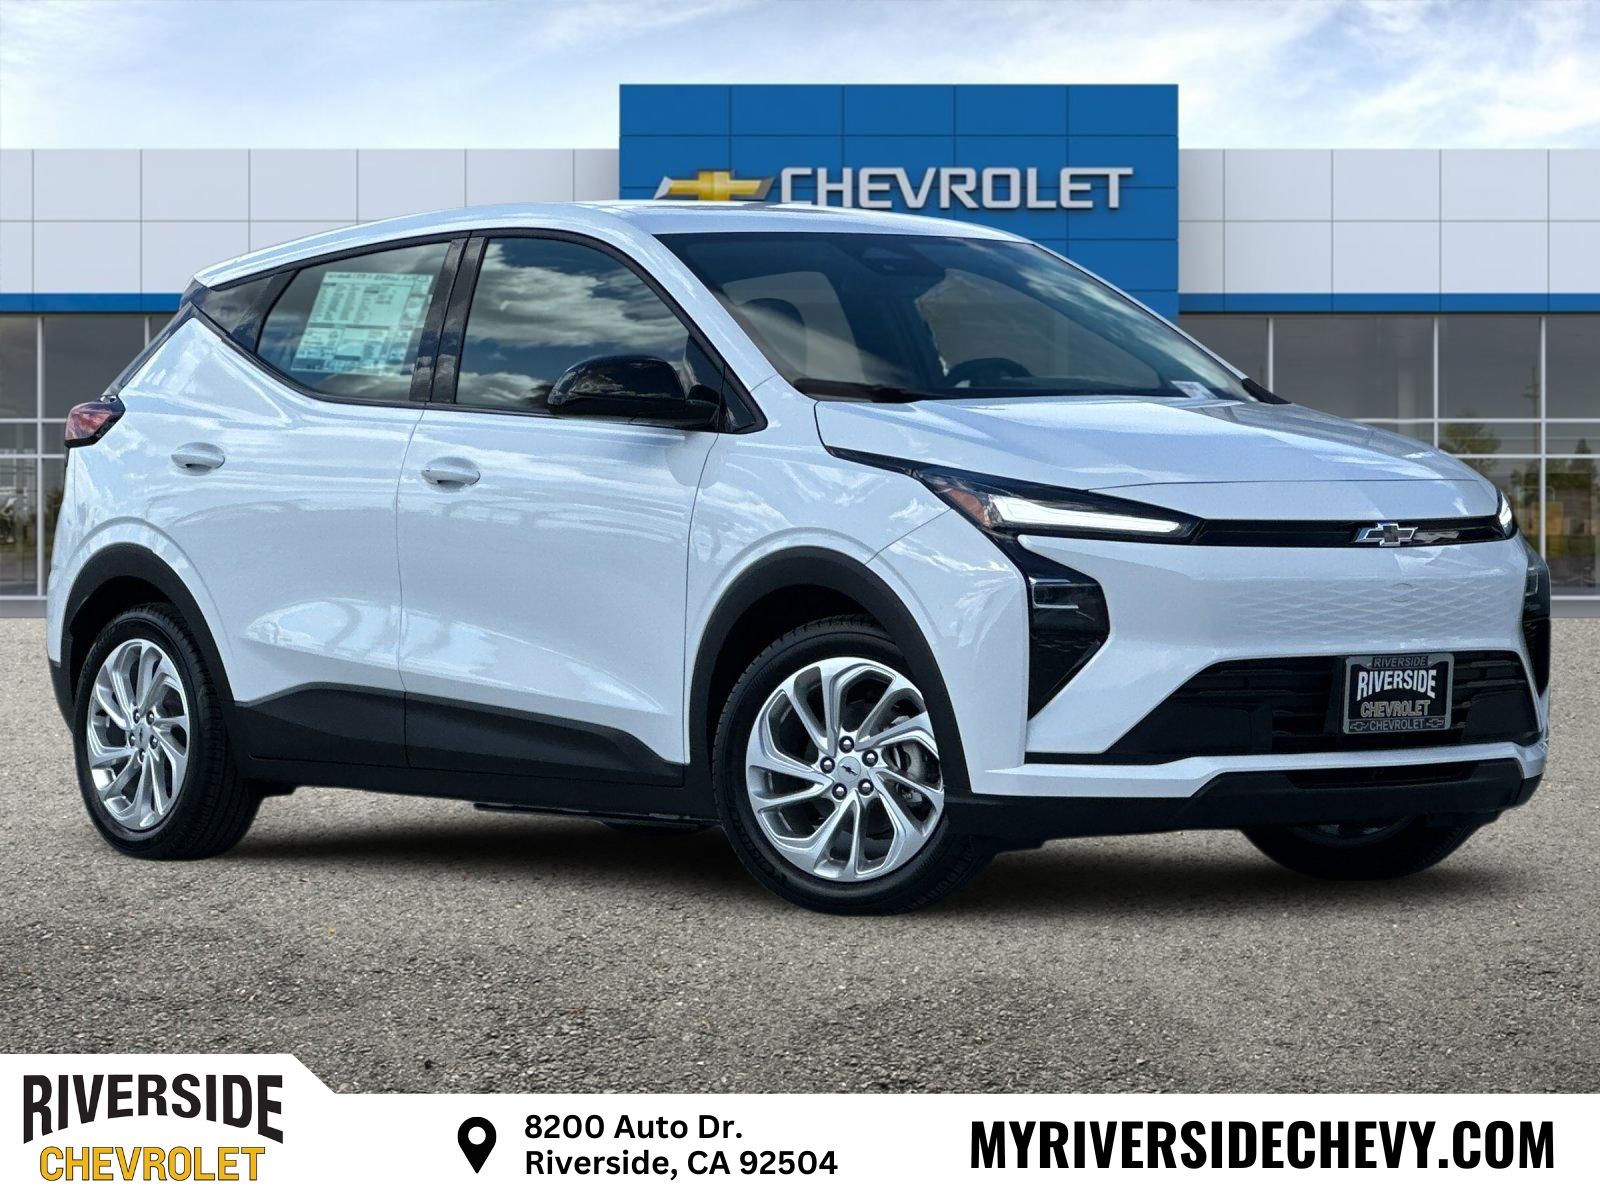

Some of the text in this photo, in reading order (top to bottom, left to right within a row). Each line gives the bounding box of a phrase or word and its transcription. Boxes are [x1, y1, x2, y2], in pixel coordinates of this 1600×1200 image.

[780, 166, 1134, 209] CHEVROLET
[1373, 656, 1427, 668] RIVERSIDE
[1356, 669, 1437, 701] RIVERSIDE
[1360, 699, 1431, 718] CHEVROLET
[1369, 718, 1425, 731] CHEVROLET
